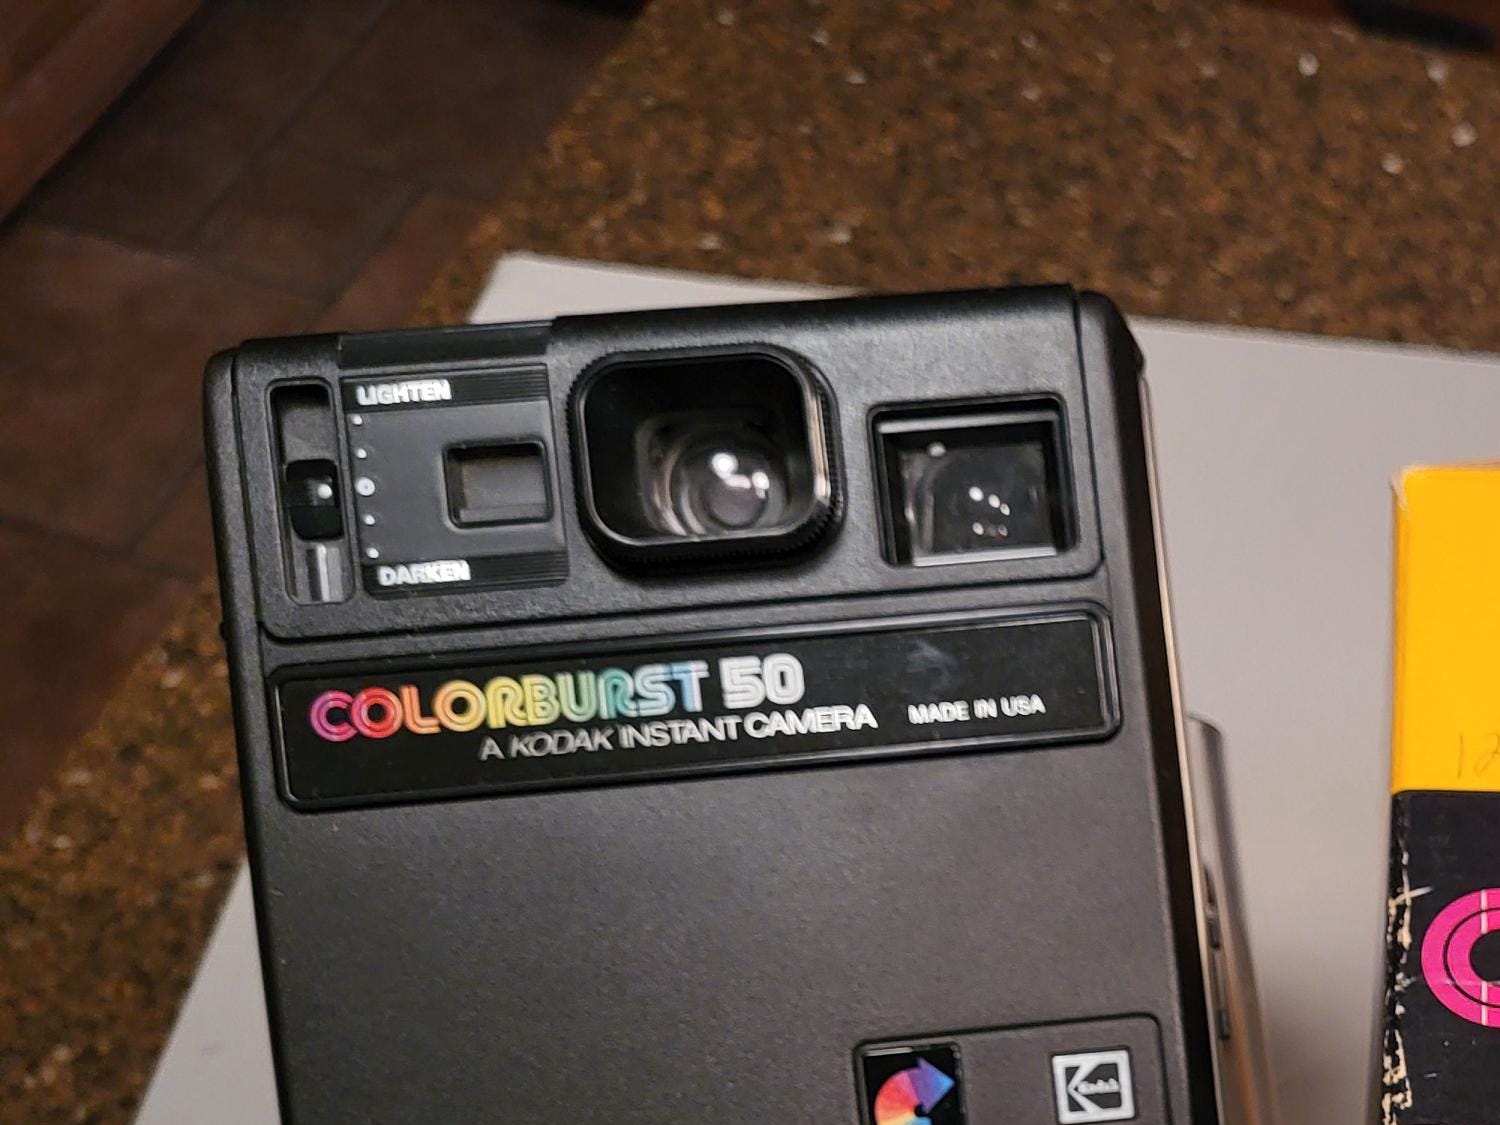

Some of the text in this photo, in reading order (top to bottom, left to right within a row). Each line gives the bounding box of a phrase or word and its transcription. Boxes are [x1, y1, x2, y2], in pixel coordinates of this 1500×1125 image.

[356, 378, 452, 406] LIGHTEN
[377, 559, 471, 586] DARKEN
[308, 653, 804, 743] COLORBURST 50
[907, 694, 1046, 724] MADE IN USA
[478, 703, 878, 761] A KODAK INSTANT CAMERA
